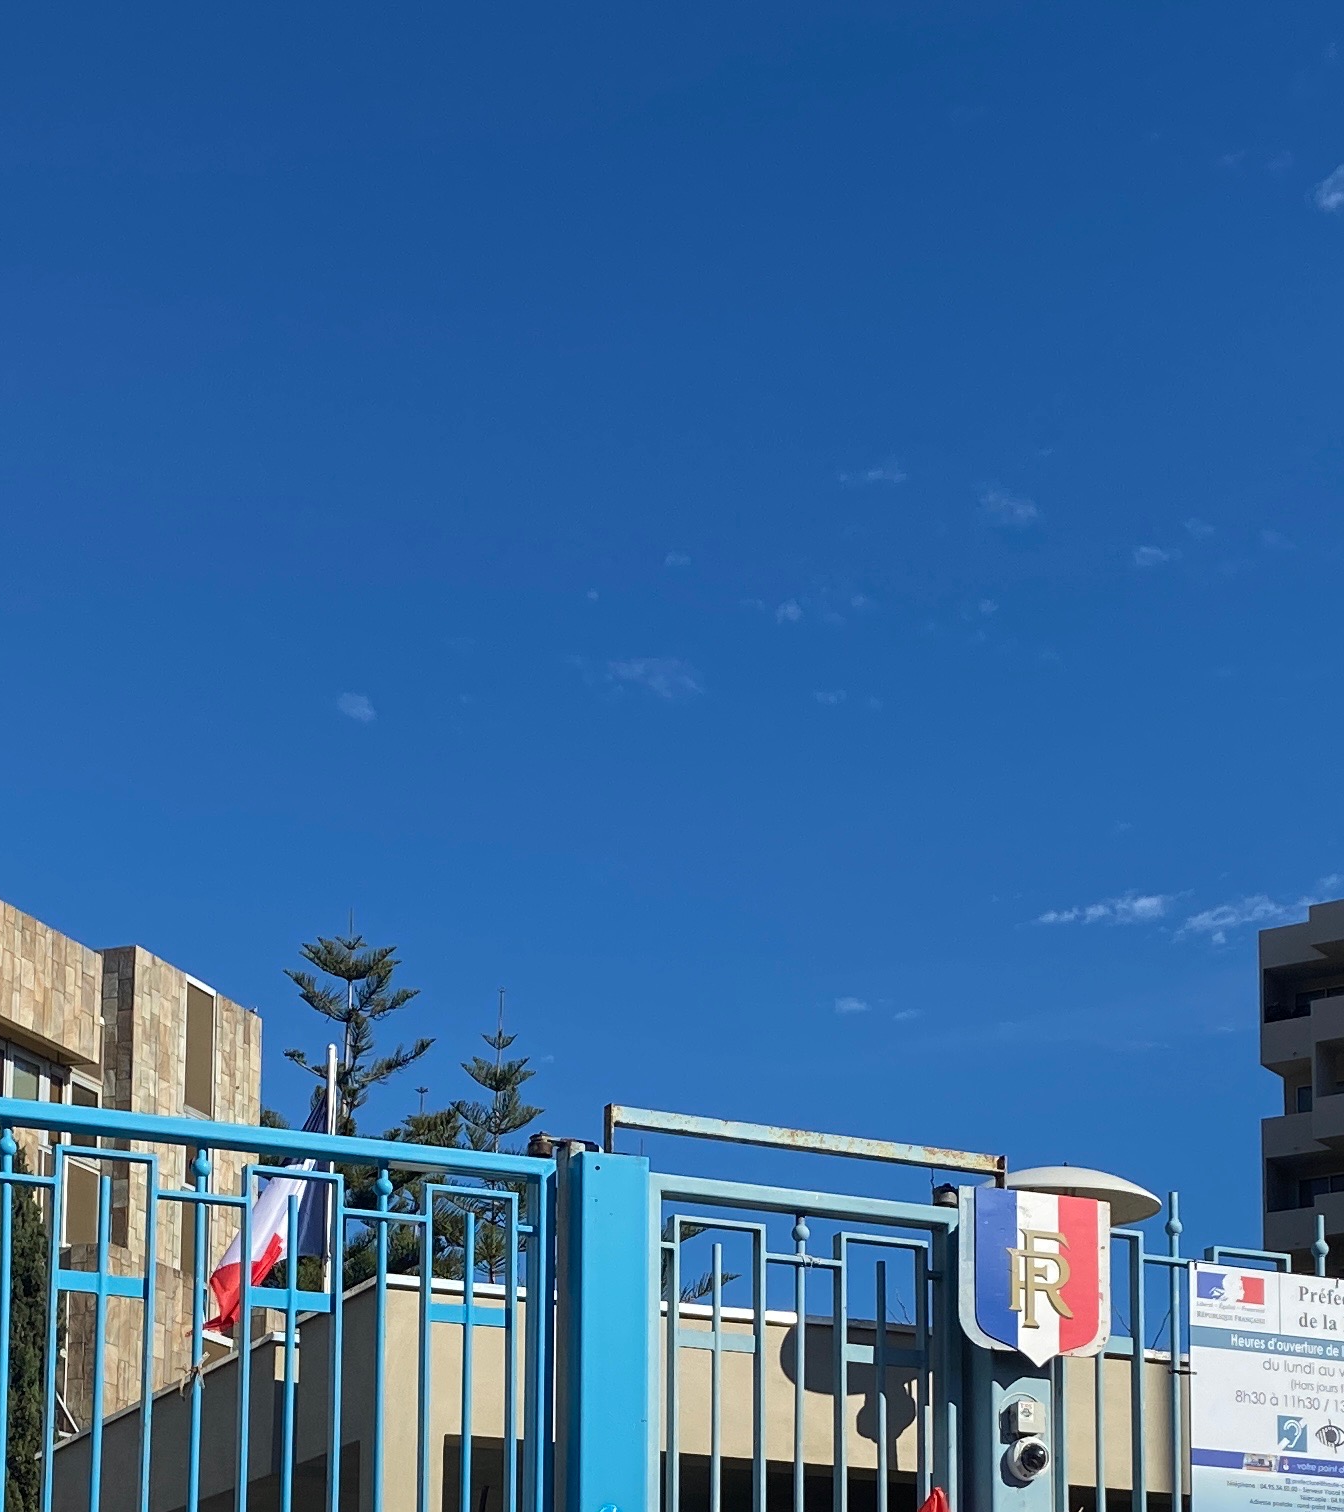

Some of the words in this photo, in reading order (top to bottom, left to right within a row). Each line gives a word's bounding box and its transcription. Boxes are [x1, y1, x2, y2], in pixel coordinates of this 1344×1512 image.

[1299, 1312, 1318, 1328] de
[1322, 1314, 1338, 1331] la
[1230, 1333, 1266, 1350] Heures
[1267, 1337, 1324, 1357] d'ouverture
[1325, 1344, 1339, 1357] de
[1262, 1358, 1280, 1371] du
[1283, 1360, 1315, 1376] lundi
[1318, 1365, 1336, 1378] au
[1315, 1381, 1338, 1394] jours
[1235, 1389, 1267, 1405] 8h30
[1269, 1392, 1279, 1406] à
[1283, 1394, 1321, 1411] 11h30
[1323, 1398, 1330, 1413] /
[1297, 1462, 1317, 1472] votre
[1317, 1463, 1338, 1474] point
